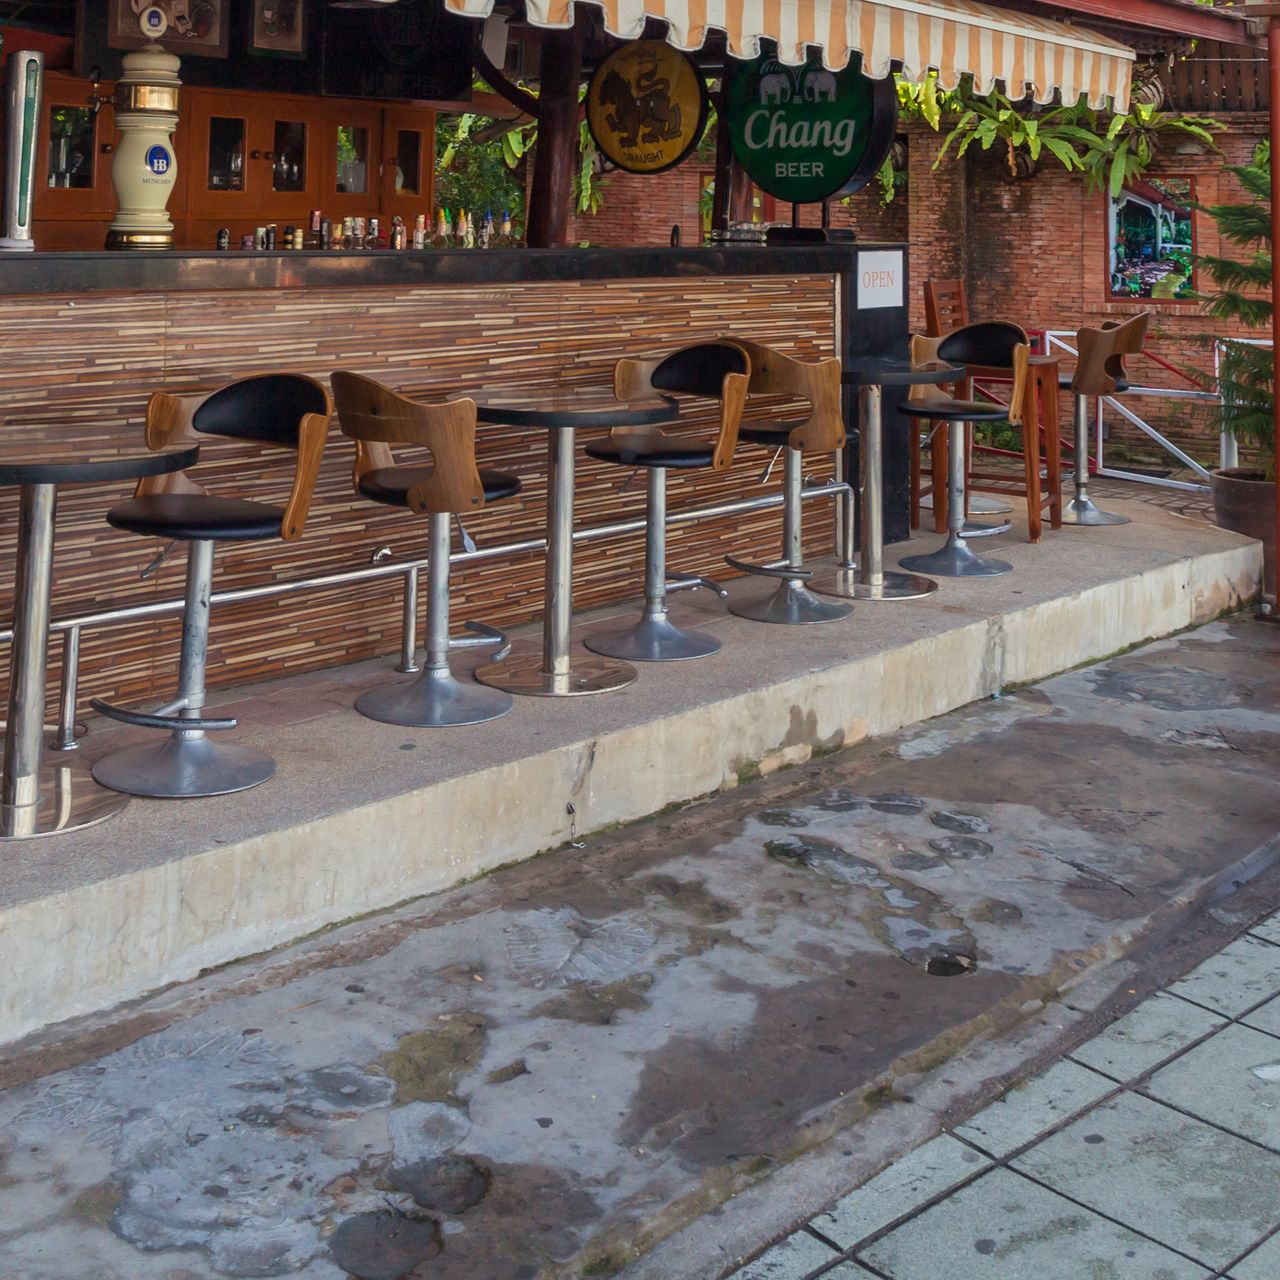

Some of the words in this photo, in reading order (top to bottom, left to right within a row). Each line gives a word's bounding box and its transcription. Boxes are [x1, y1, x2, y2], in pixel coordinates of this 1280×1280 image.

[744, 110, 856, 156] Chang
[775, 162, 824, 177] BEER
[863, 271, 895, 288] OPEN
